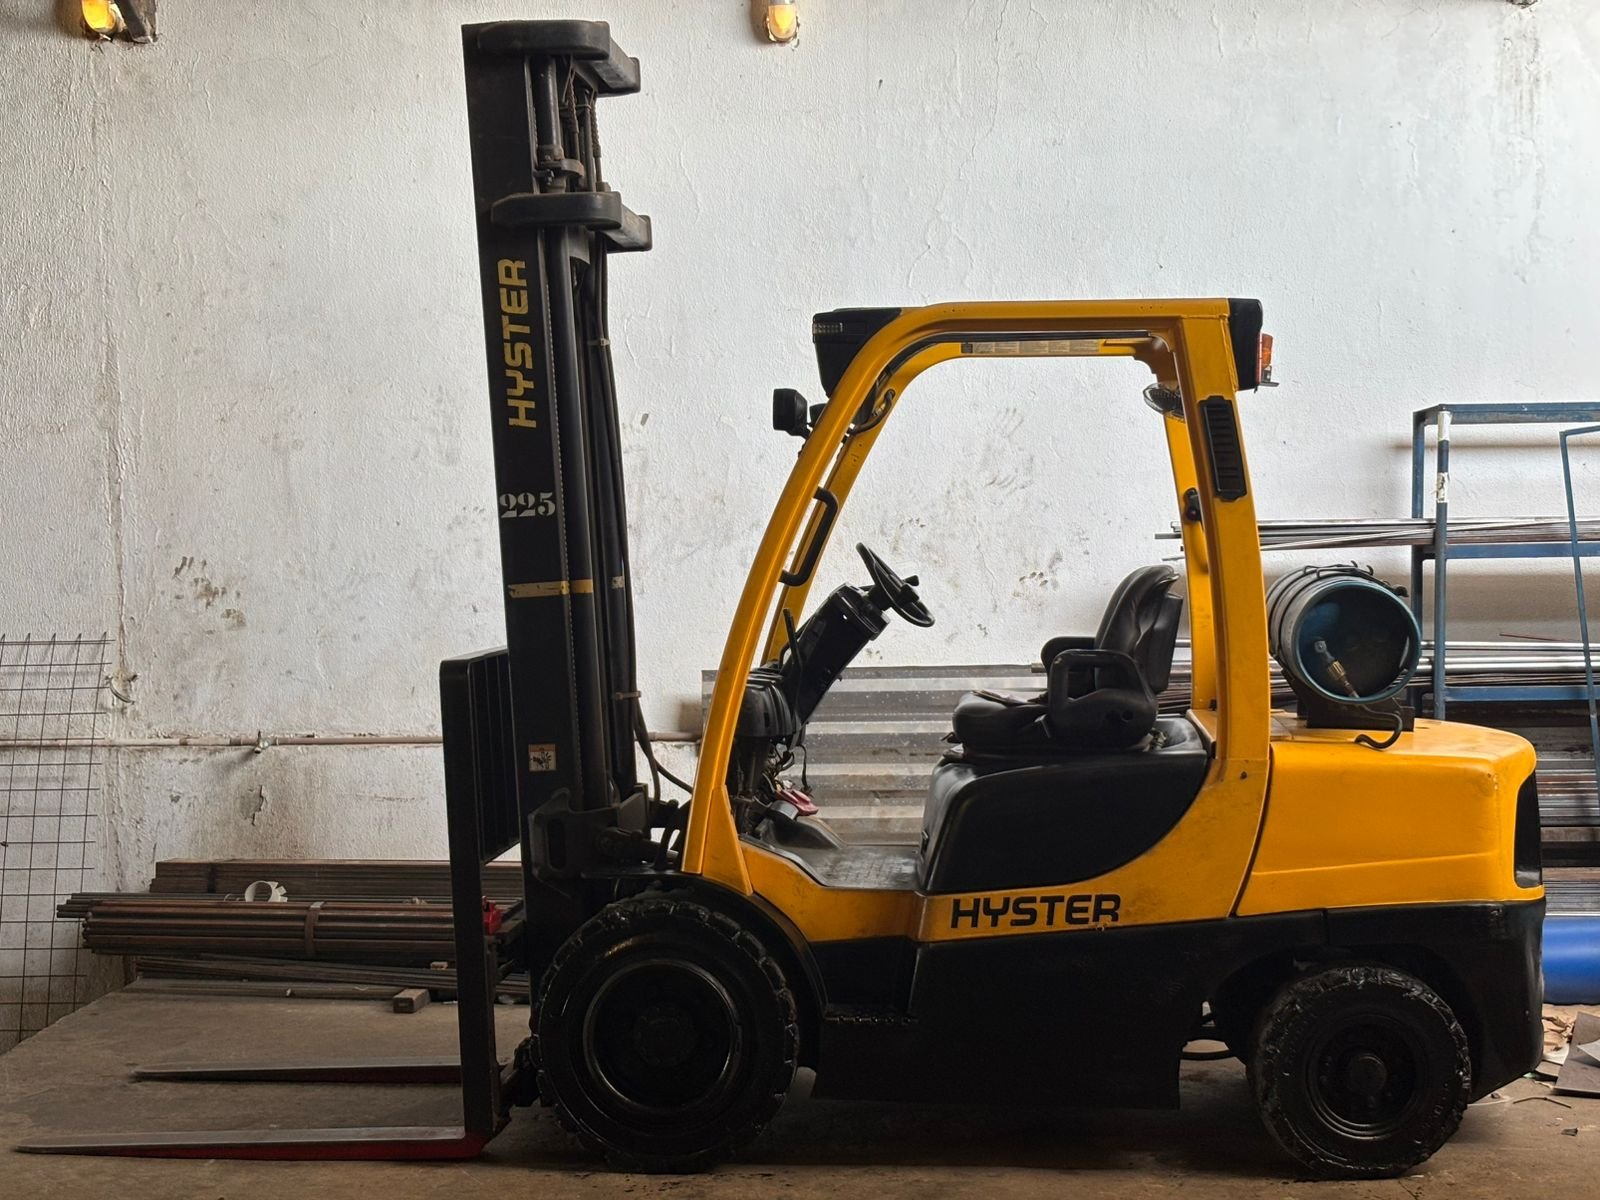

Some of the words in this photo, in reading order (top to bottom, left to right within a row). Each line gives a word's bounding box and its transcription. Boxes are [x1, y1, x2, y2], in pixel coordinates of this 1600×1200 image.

[497, 259, 537, 428] HYSTER
[499, 491, 557, 519] 225
[951, 894, 1121, 928] HYSTER
